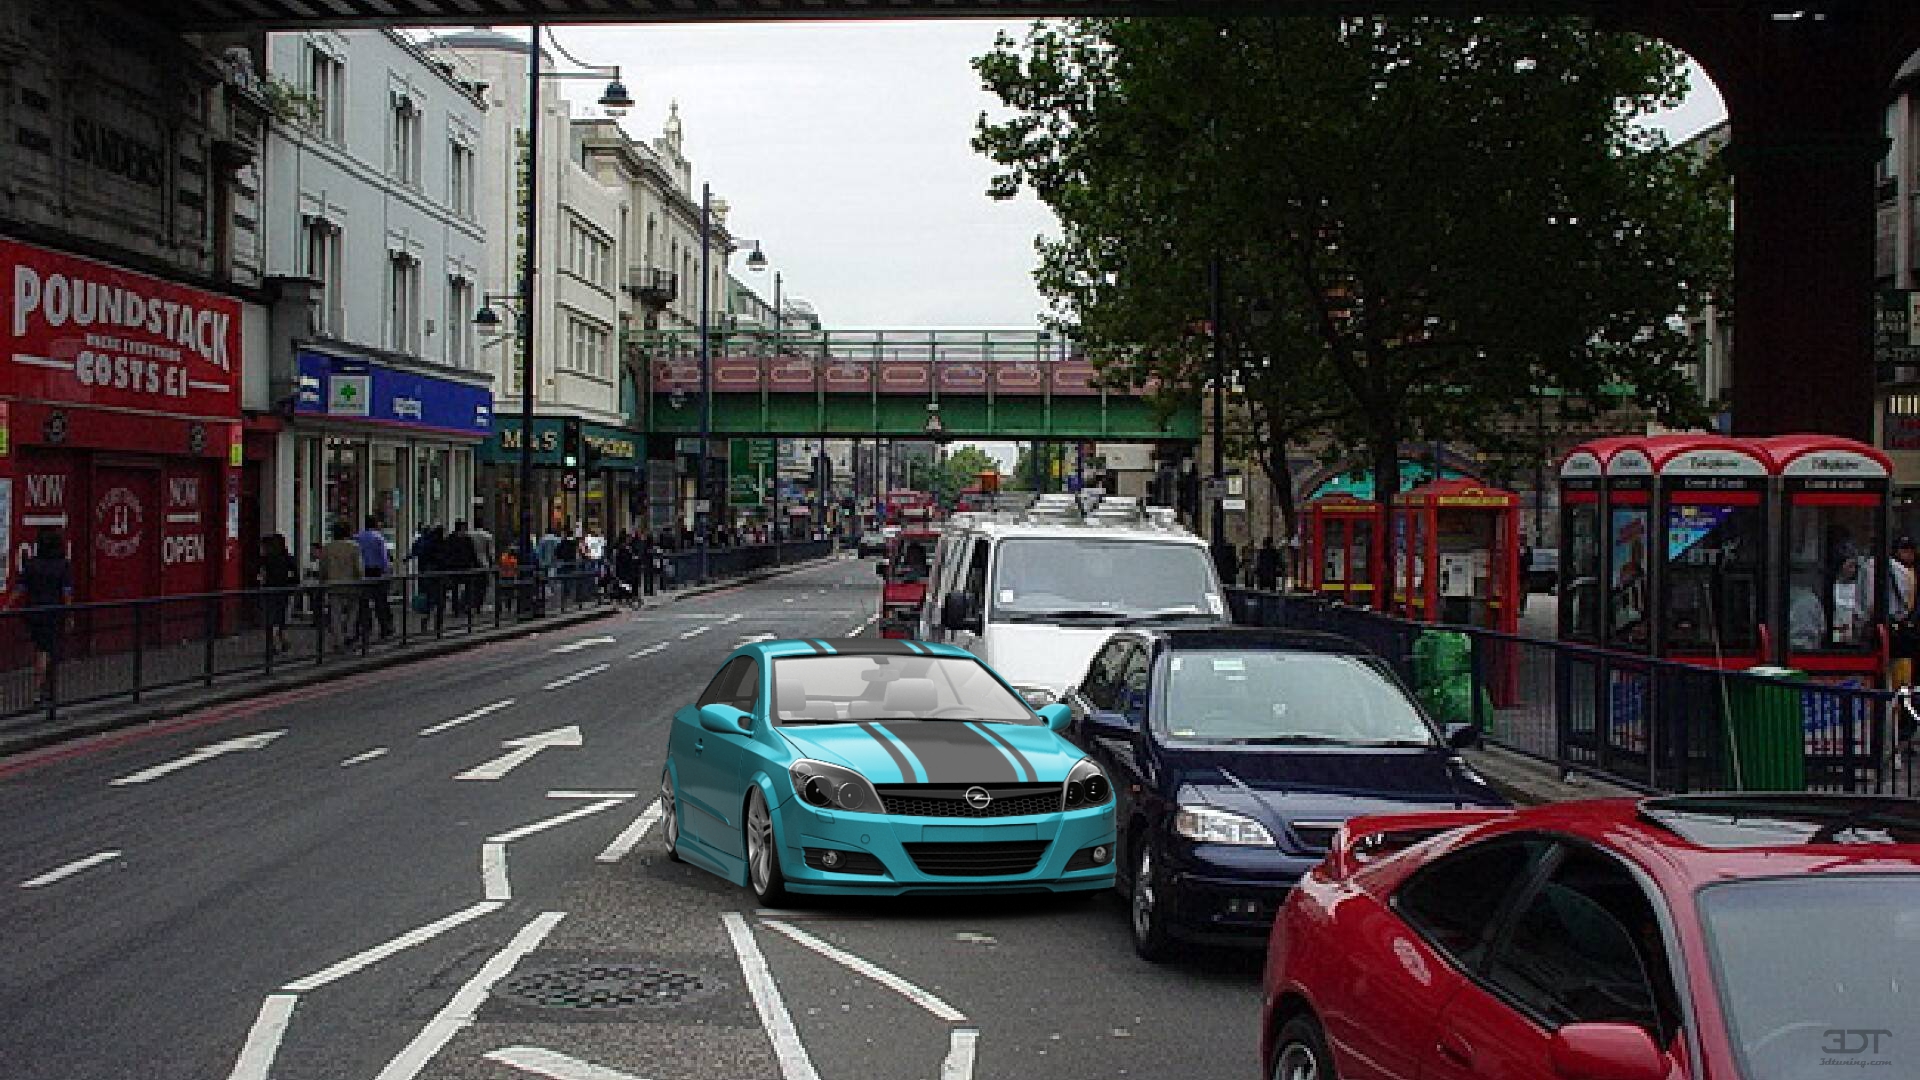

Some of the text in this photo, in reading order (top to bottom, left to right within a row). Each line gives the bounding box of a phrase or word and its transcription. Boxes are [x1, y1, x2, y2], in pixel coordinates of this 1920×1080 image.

[14, 265, 229, 371] POUNDSTACK
[77, 350, 159, 393] COSTS
[25, 474, 66, 507] NOW
[168, 477, 199, 507] NOW
[163, 533, 205, 566] OPEN
